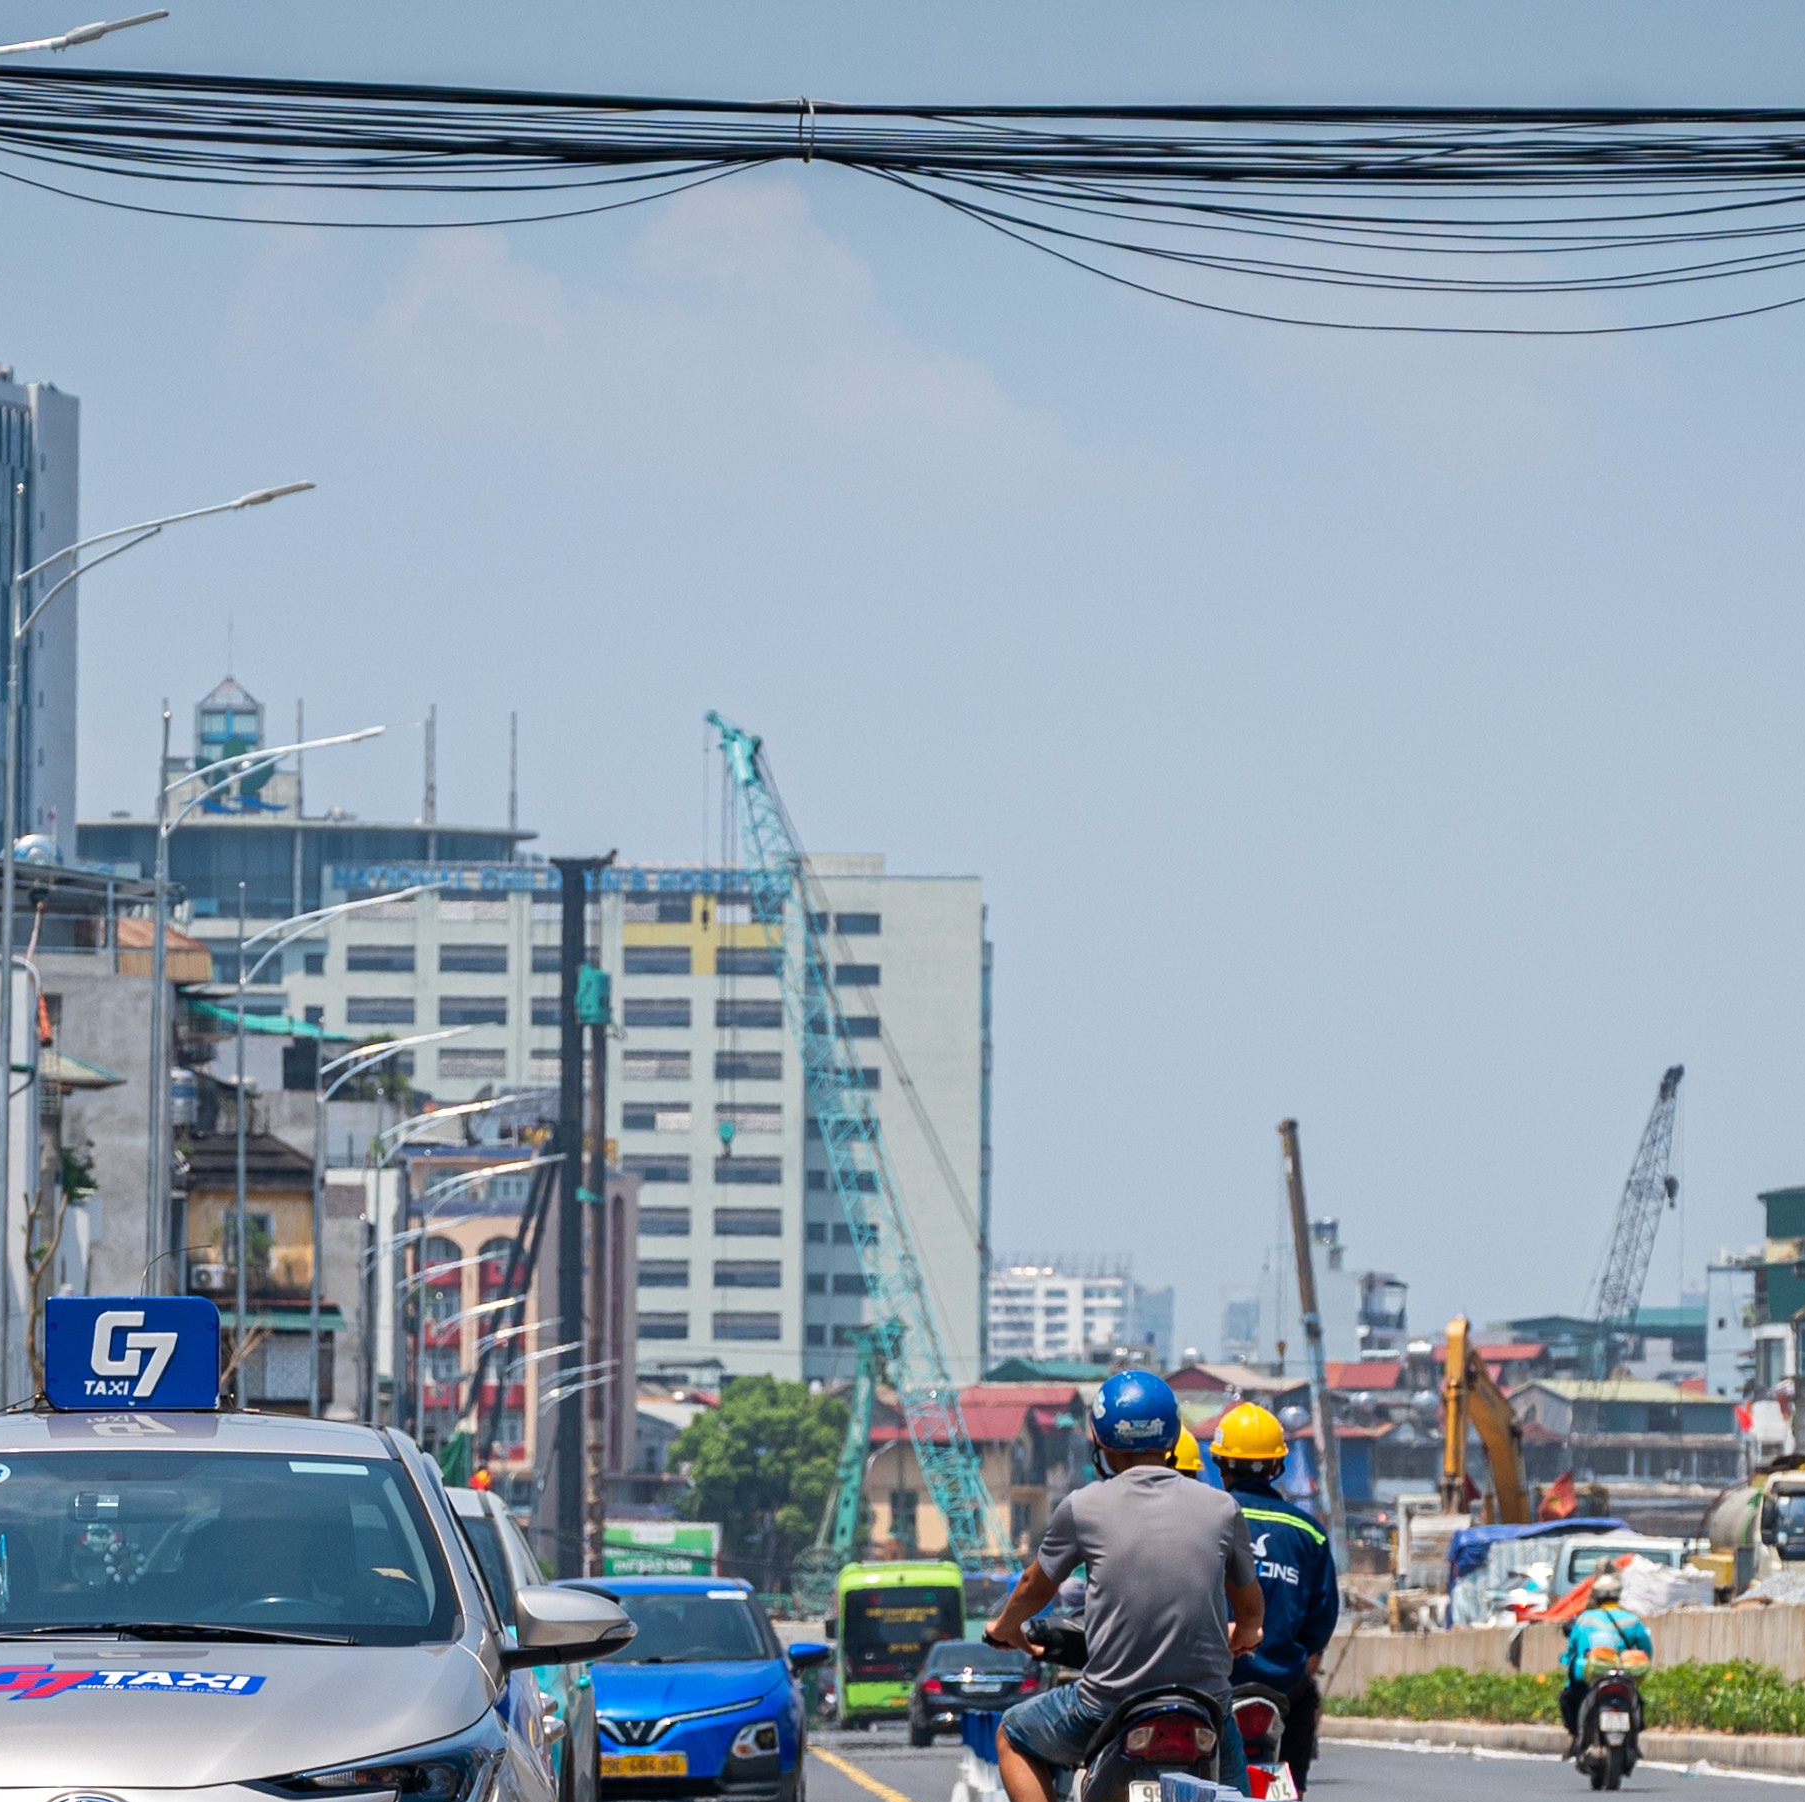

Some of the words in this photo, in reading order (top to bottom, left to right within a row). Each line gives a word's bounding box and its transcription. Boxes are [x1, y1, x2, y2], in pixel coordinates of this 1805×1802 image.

[482, 867, 647, 891] CHILDEN'S
[91, 1311, 178, 1397] G7
[84, 1380, 130, 1396] TAXI
[99, 1670, 250, 1690] TAXI
